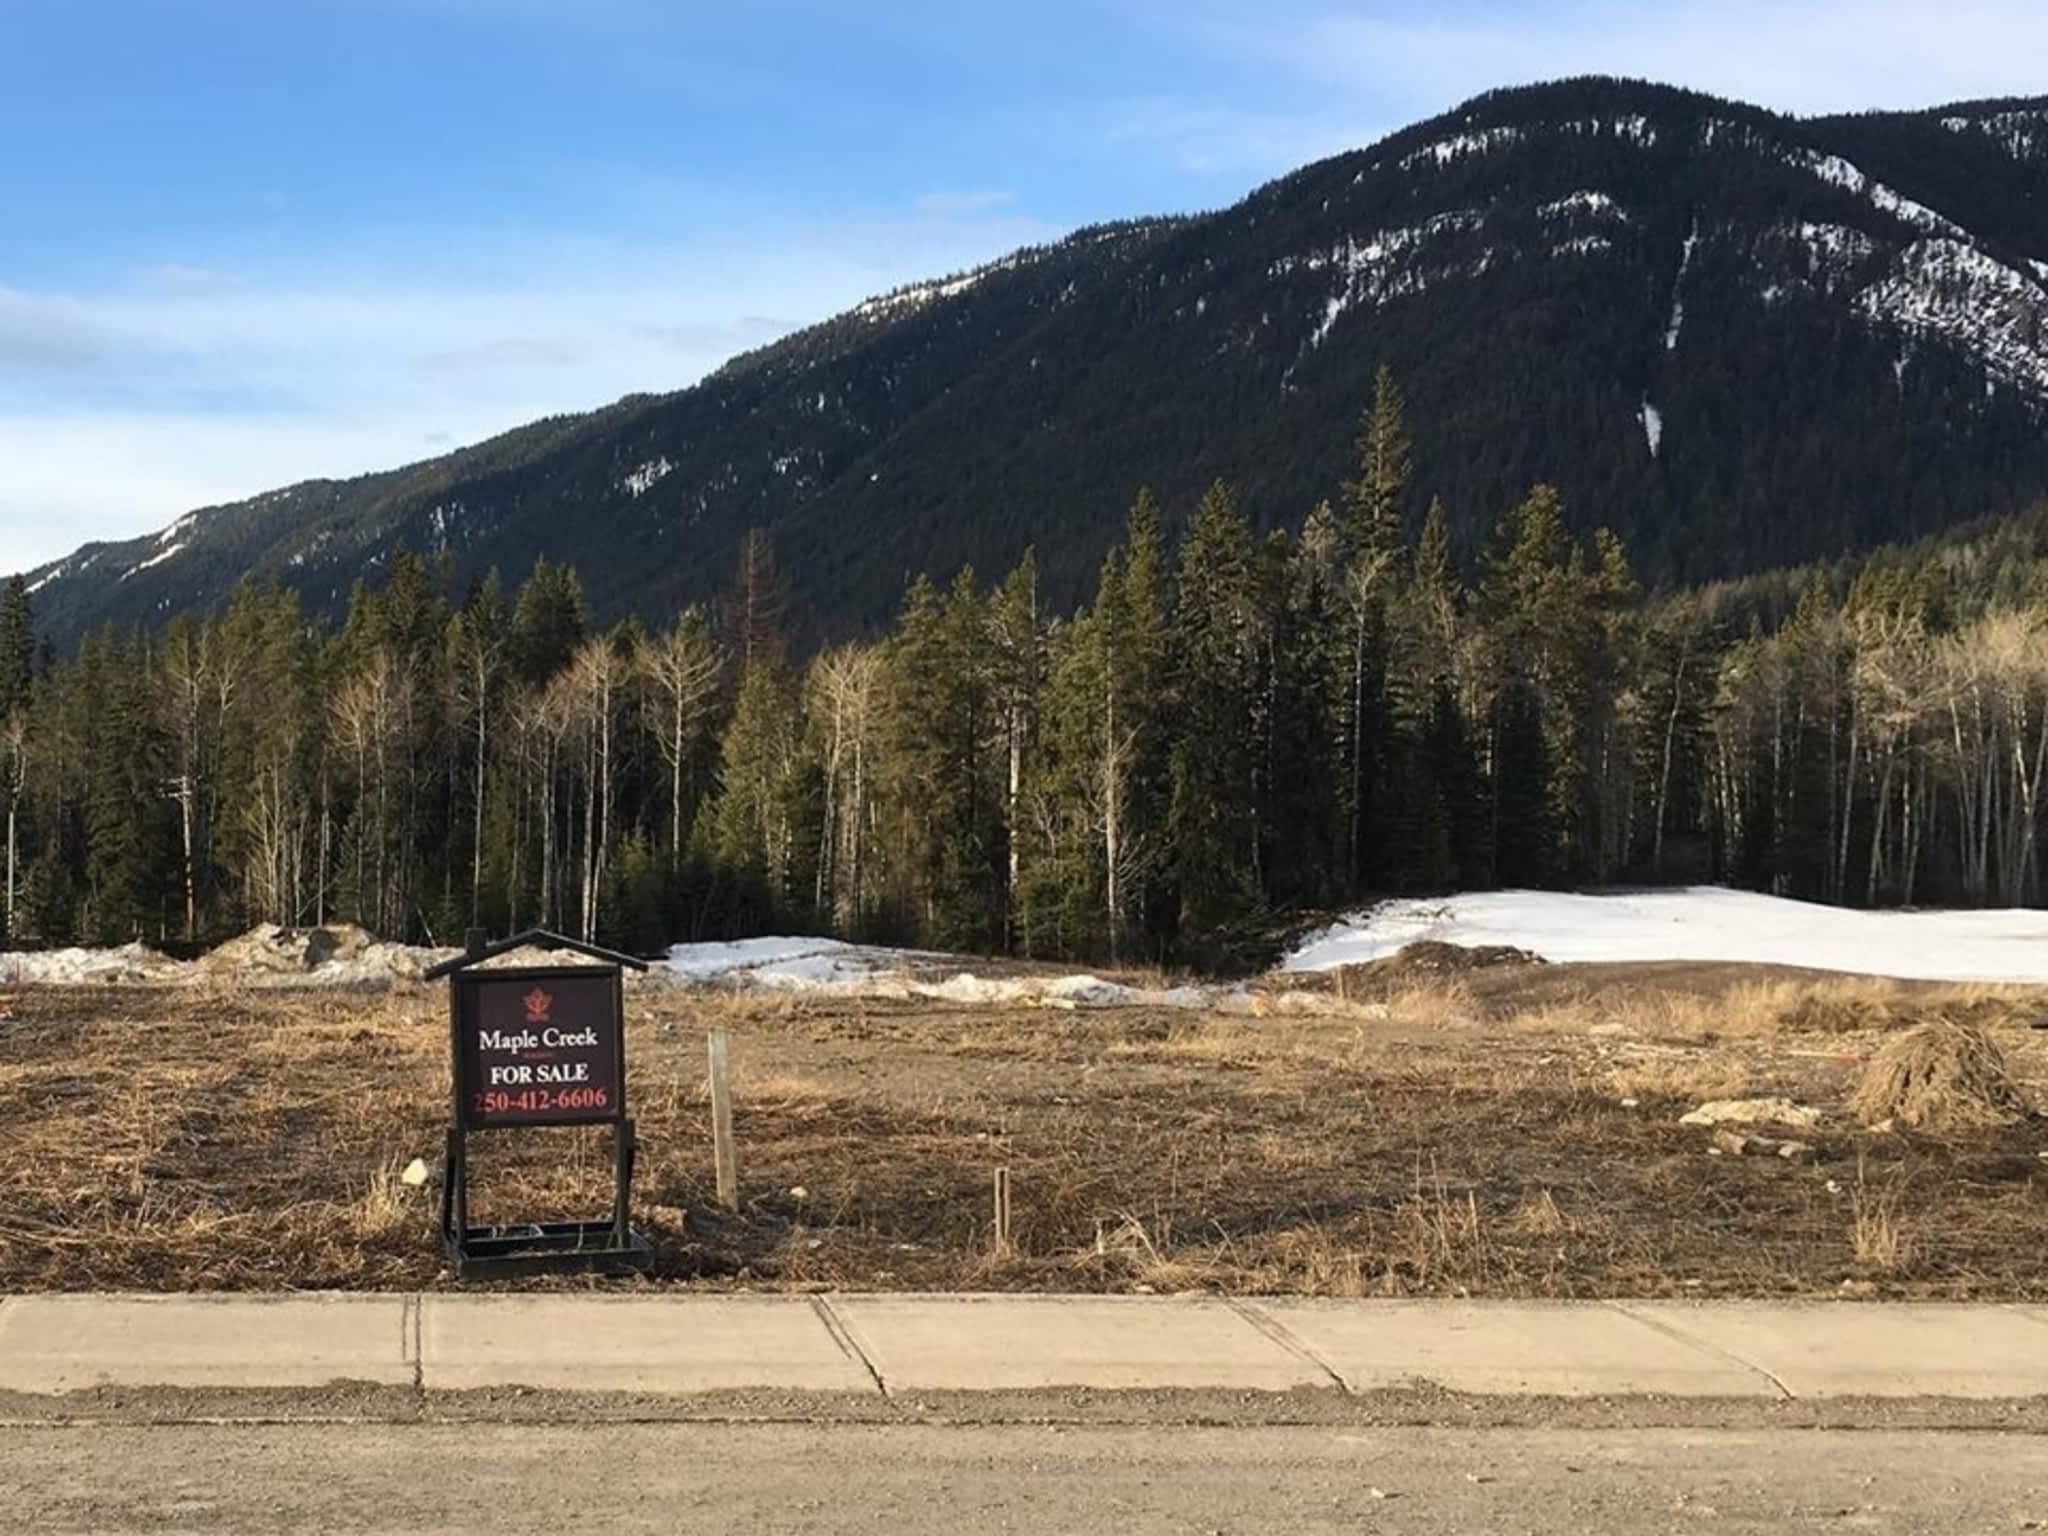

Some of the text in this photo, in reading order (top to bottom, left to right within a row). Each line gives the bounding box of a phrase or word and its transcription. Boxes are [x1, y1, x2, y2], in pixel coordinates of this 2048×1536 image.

[479, 1026, 598, 1055] Maple Creek
[490, 1063, 589, 1085] FOR SALE
[474, 1087, 607, 1113] 250-412-6606
